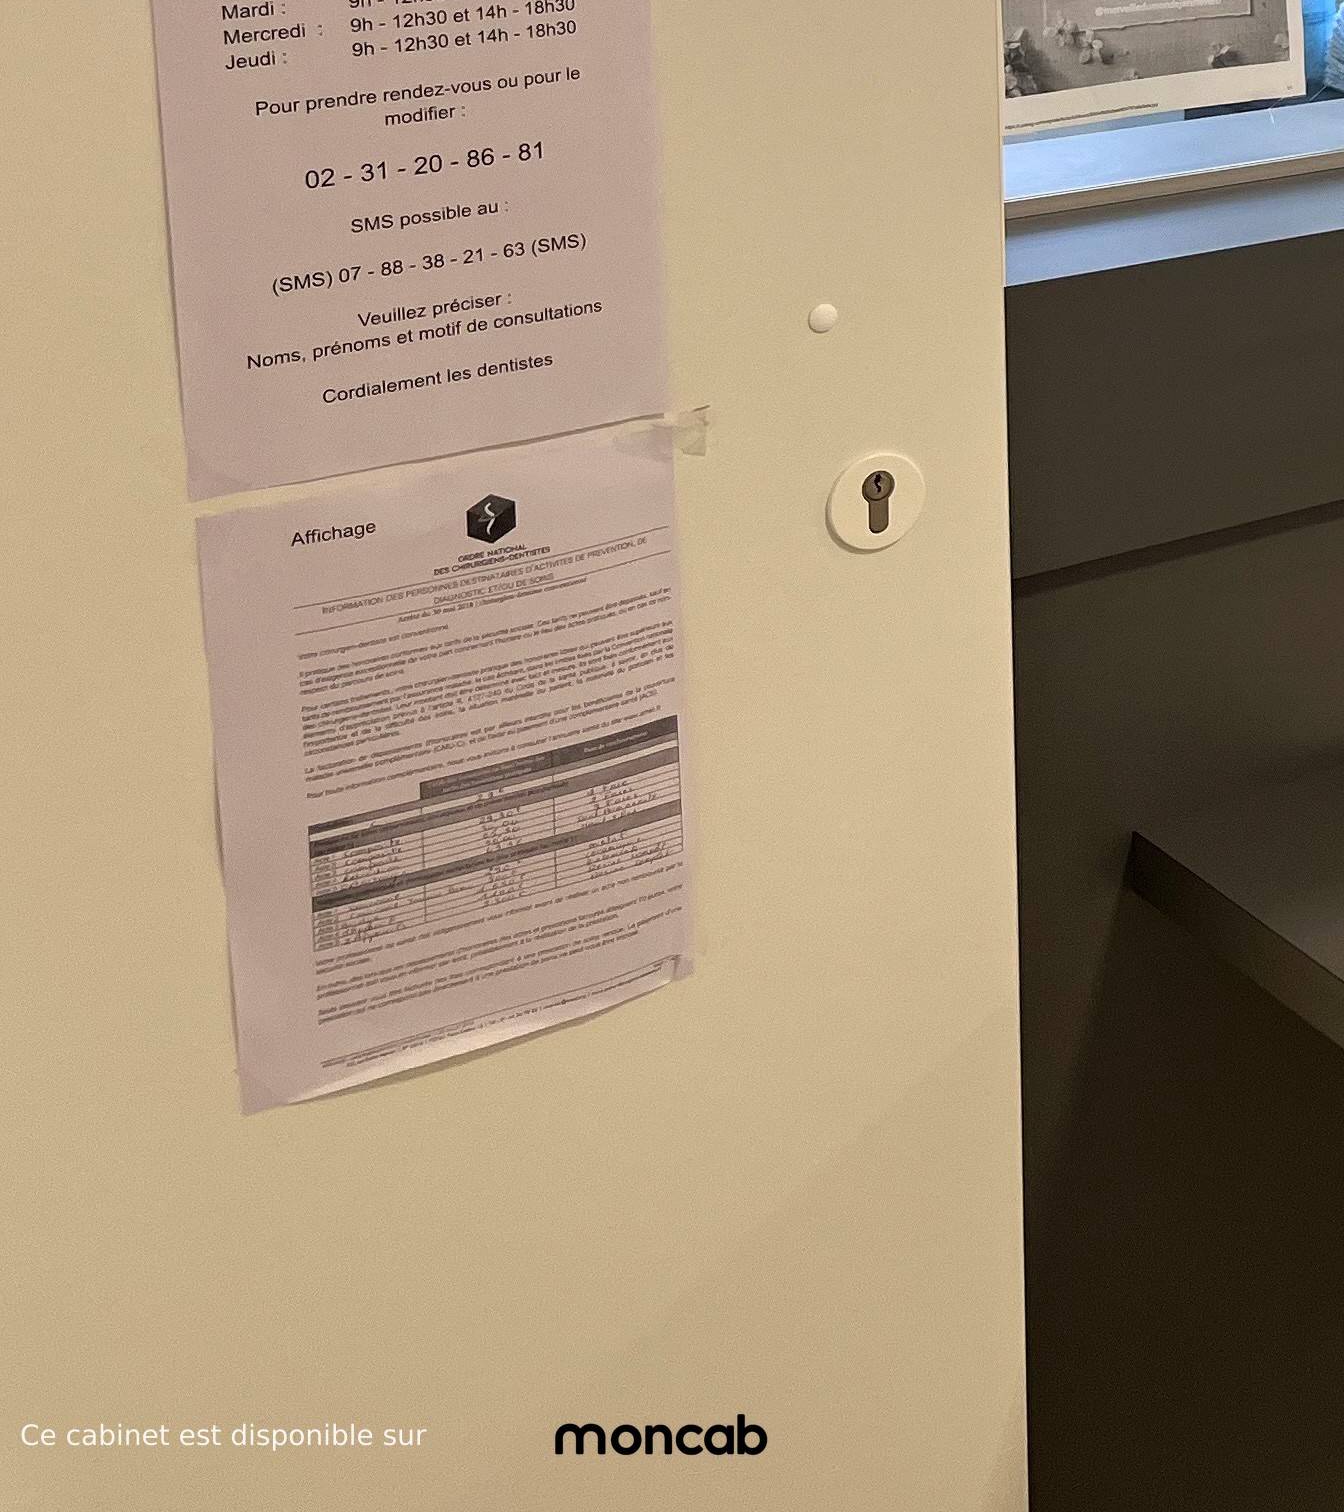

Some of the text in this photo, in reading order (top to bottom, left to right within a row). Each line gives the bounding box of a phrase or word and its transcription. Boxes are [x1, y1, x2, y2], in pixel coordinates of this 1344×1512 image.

[222, 1, 274, 20] Mardi
[224, 23, 305, 45] Mercredi
[351, 18, 372, 32] 9h
[393, 10, 447, 28] 12h30
[454, 8, 470, 22] et
[476, 5, 506, 20] 14h
[225, 51, 275, 69] Jeudi
[352, 42, 374, 56] 9h
[395, 34, 448, 52] 12h30
[455, 33, 471, 46] et
[478, 29, 508, 43] 14h
[527, 20, 576, 38] 18h30
[256, 67, 580, 115] Pour prendre rendez-vous ou pour le
[385, 106, 455, 125] modifier
[306, 169, 335, 188] 02
[361, 162, 385, 181] 31
[415, 155, 442, 175] 20
[467, 148, 494, 167] 86
[519, 142, 542, 161] 81
[352, 203, 498, 233] SMS possible au
[273, 271, 332, 296] (SMS)
[339, 266, 361, 282] 07
[381, 260, 403, 276] 88
[423, 254, 444, 270] 38
[463, 248, 482, 264] 21
[504, 242, 525, 257] 63
[532, 233, 586, 257] (SMS)
[358, 295, 501, 326] Veuillez préciser
[248, 302, 602, 369] Noms, prénoms et motif de consultations
[323, 356, 552, 403] Cordialement les dentistes
[291, 523, 375, 546] Affichage
[458, 544, 527, 563] ORDRE NATIONAL
